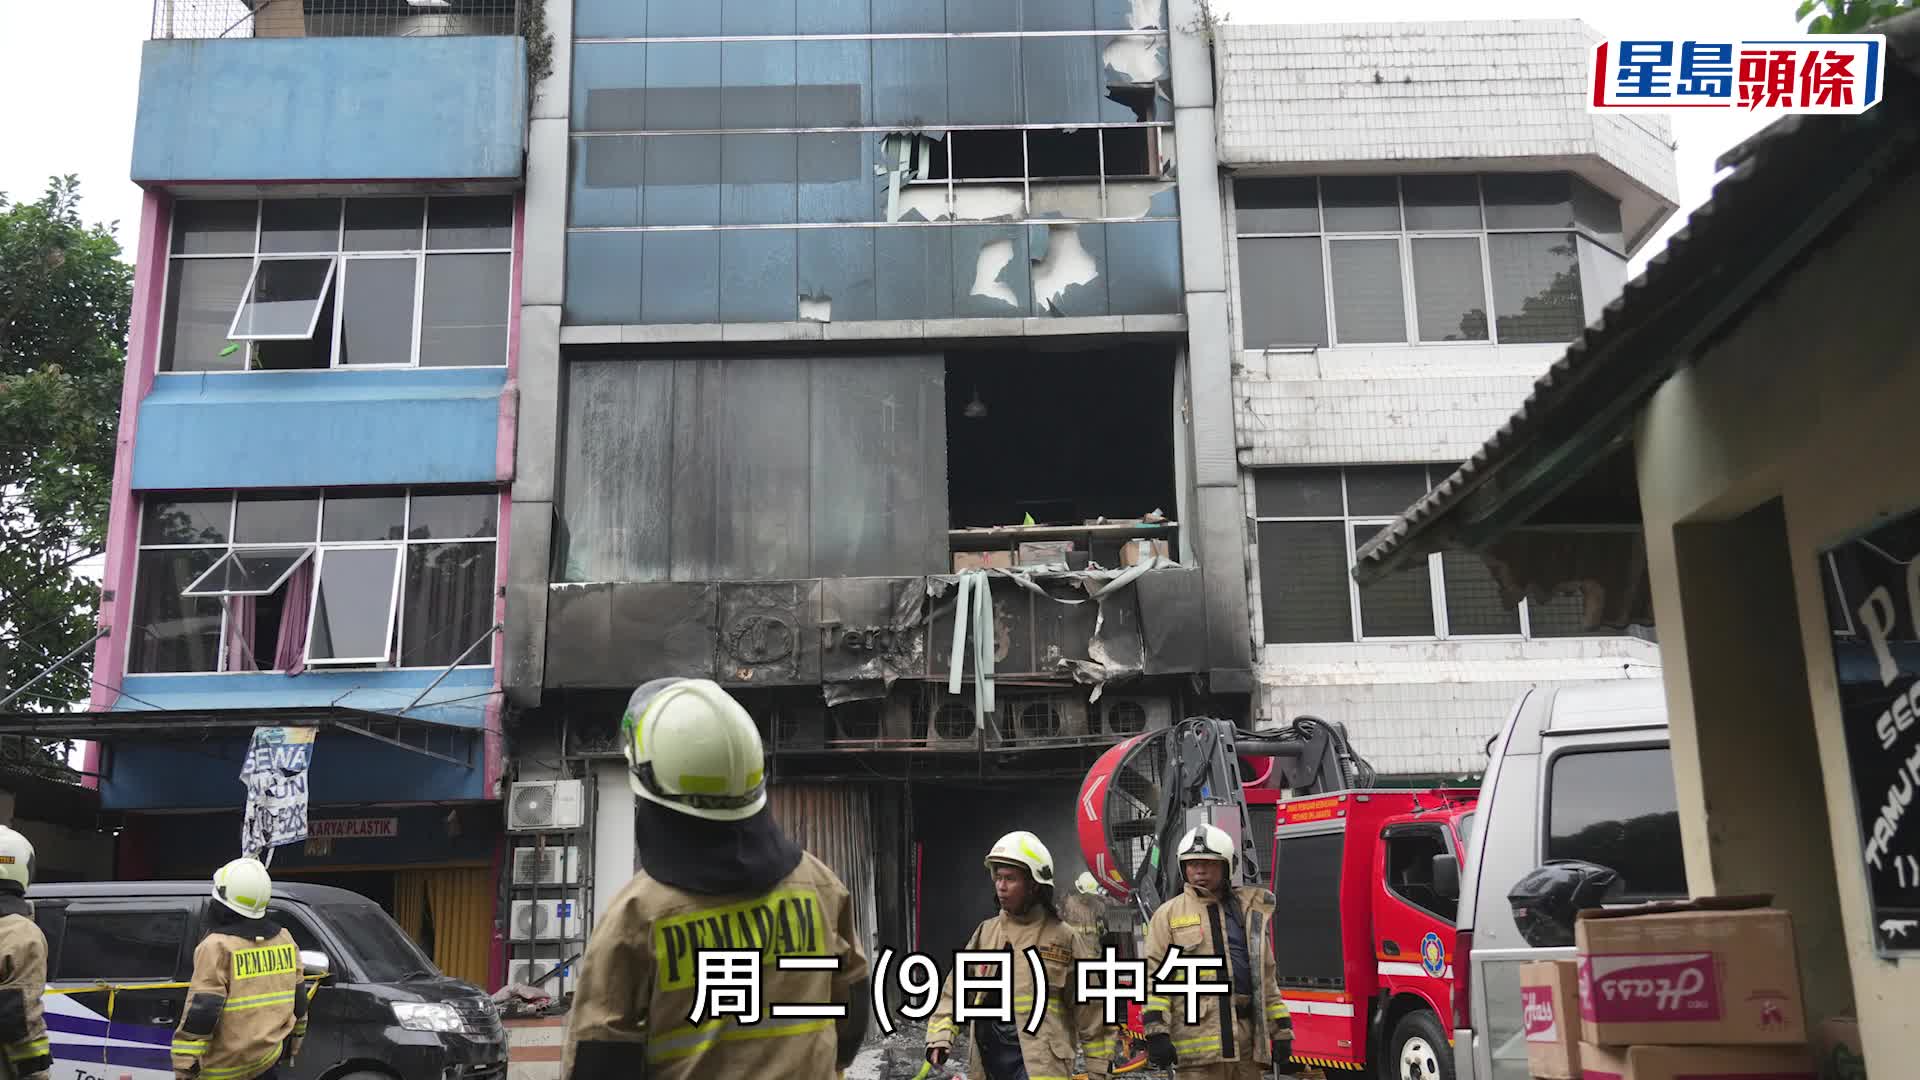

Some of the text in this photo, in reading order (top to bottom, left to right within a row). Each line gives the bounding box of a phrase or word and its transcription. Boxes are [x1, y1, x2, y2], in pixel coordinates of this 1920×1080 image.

[243, 746, 308, 774] SEWA
[308, 819, 391, 836] KARYA PLASTIK
[662, 896, 817, 983] PEMADAM
[236, 947, 294, 976] PEMADAM
[1601, 967, 1705, 1011] Hass
